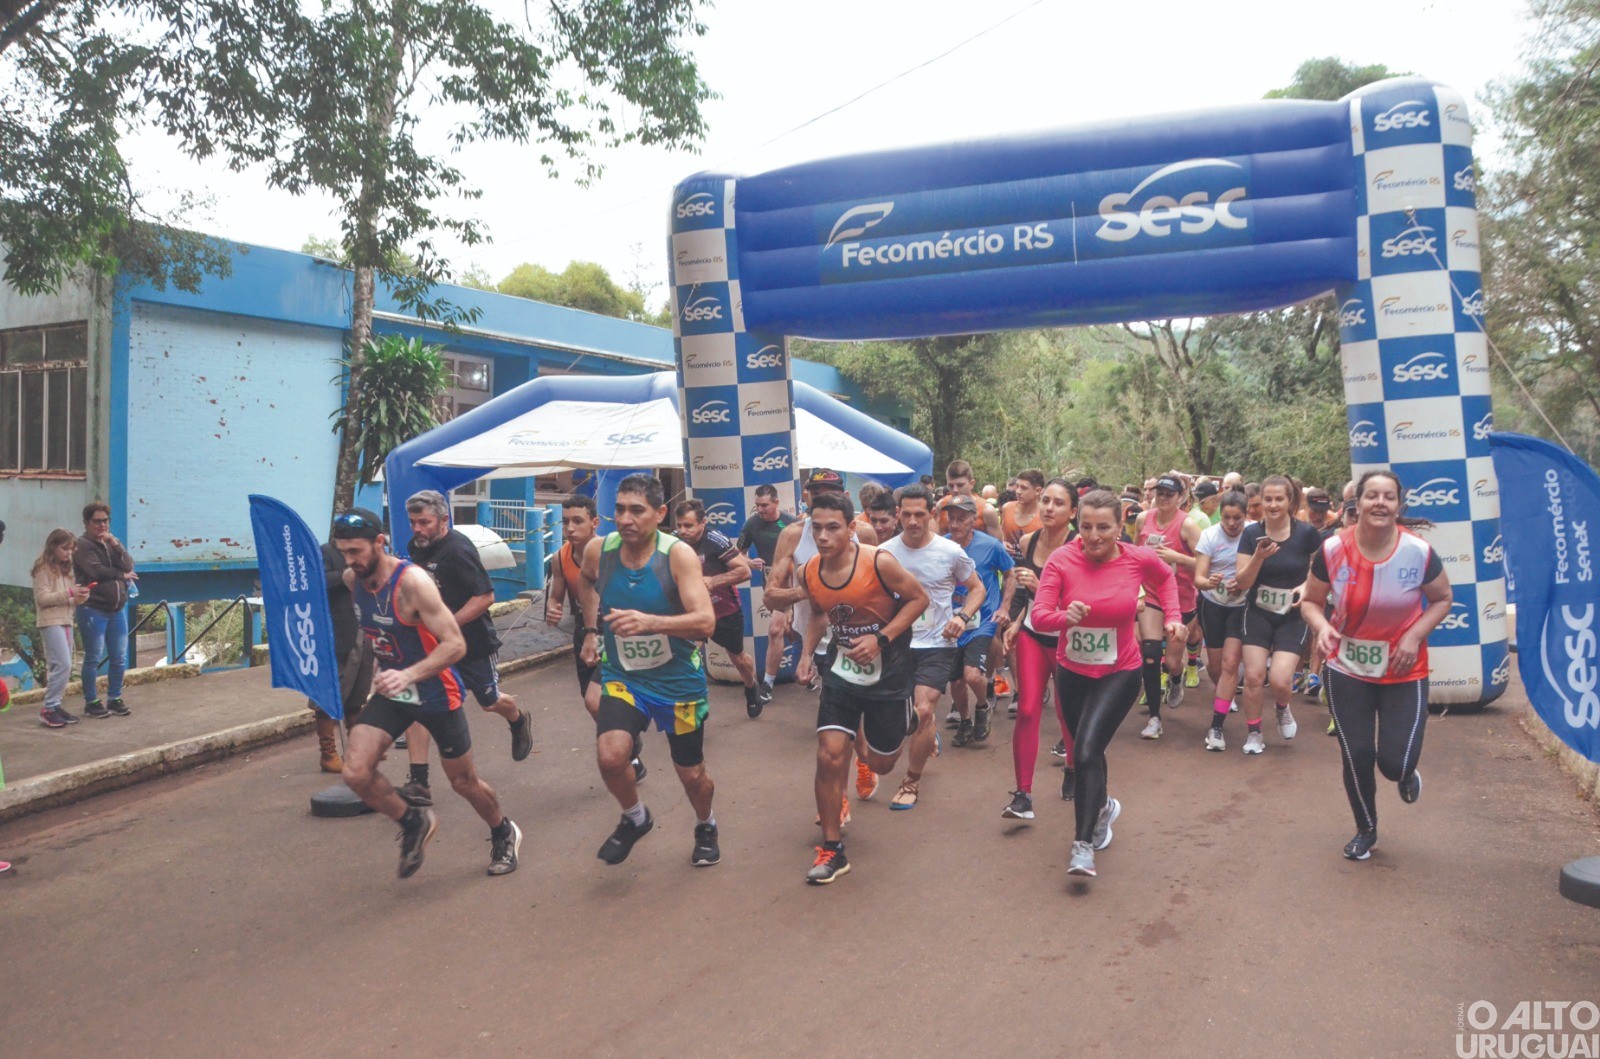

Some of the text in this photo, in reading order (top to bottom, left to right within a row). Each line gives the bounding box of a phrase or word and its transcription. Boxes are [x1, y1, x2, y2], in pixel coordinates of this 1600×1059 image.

[842, 222, 1054, 267] Fecomércio RS
[1339, 308, 1366, 327] esc
[1544, 469, 1570, 584] Fecomércio
[283, 524, 298, 592] Fecomércio
[1460, 554, 1471, 562] RS
[1261, 590, 1286, 606] 611
[623, 639, 664, 659] 552
[1072, 631, 1109, 653] 634
[1345, 642, 1382, 664] 568
[1428, 678, 1466, 686] comércio
